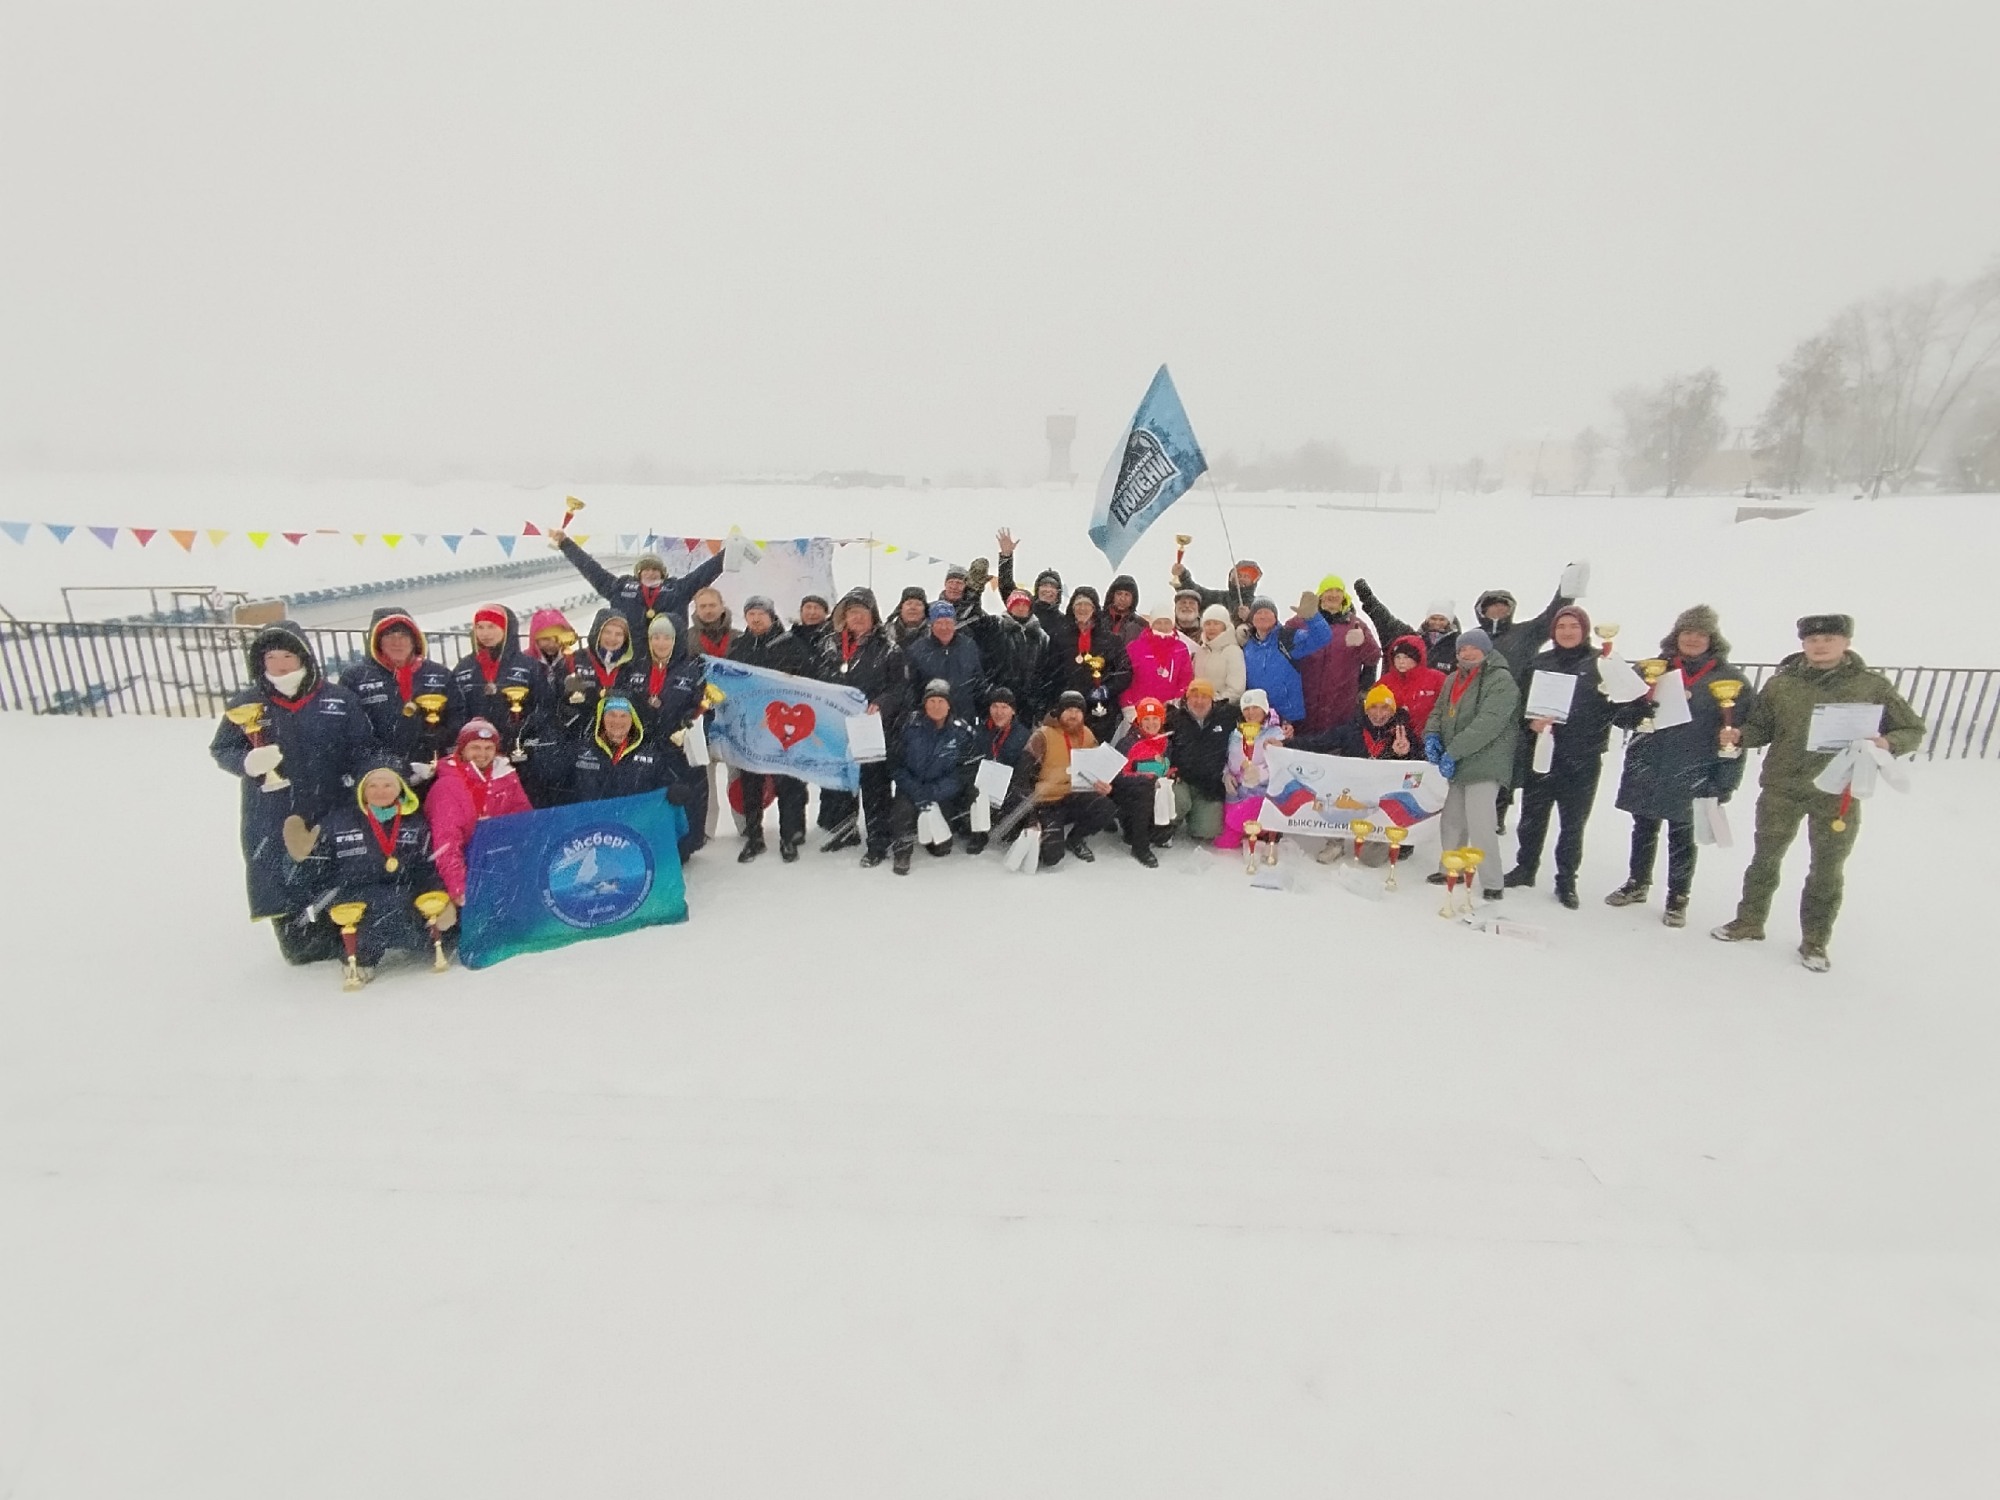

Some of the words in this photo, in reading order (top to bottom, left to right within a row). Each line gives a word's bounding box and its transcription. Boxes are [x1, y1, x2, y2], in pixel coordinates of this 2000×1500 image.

[1114, 453, 1173, 522] ТЮЛЕНИ
[1288, 818, 1350, 831] ВЫКСУНСКИ
[563, 832, 631, 860] Айсберг
